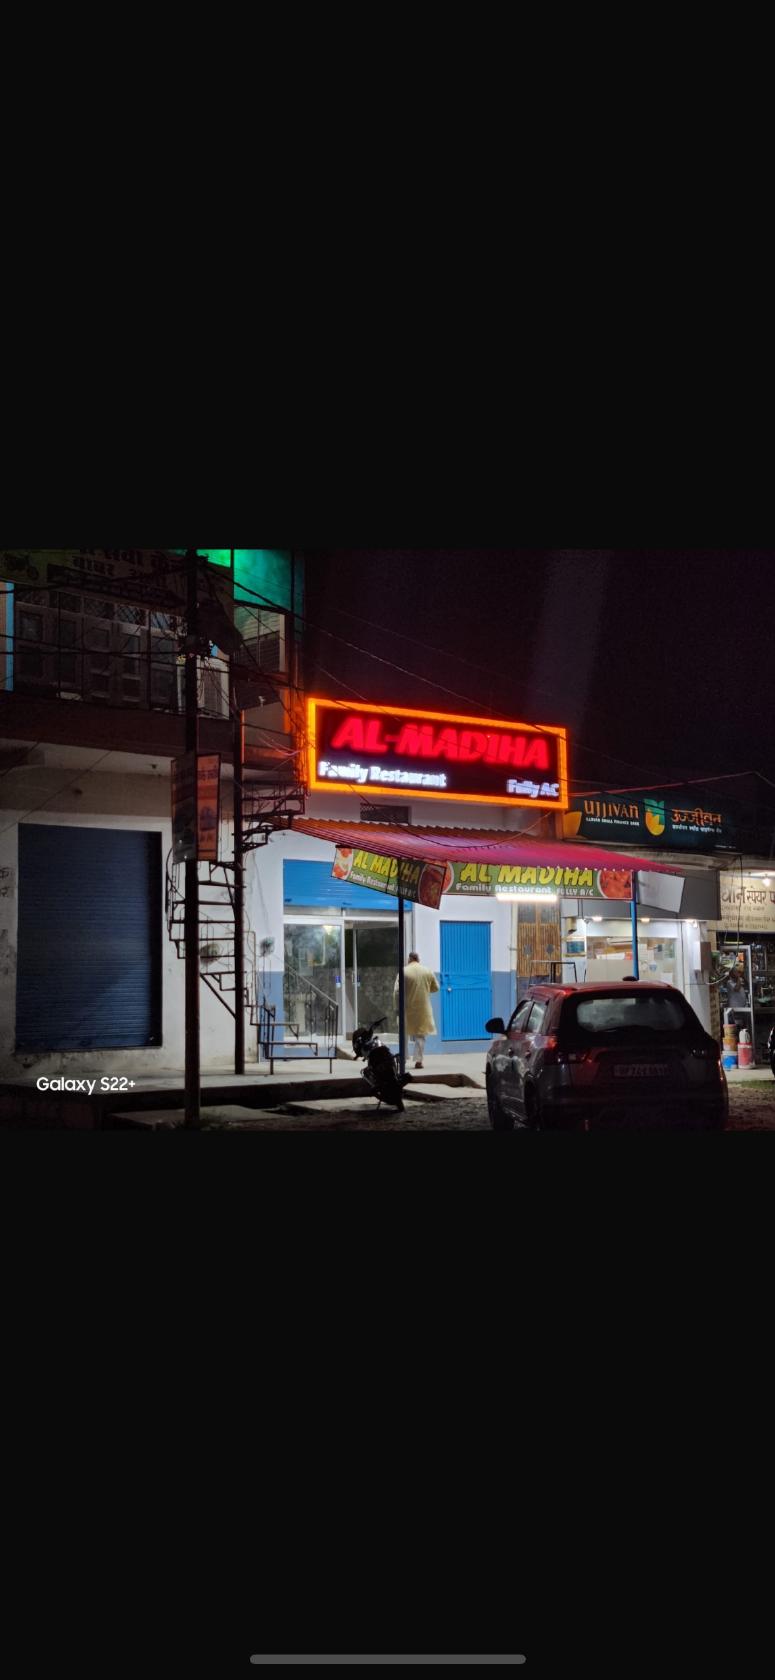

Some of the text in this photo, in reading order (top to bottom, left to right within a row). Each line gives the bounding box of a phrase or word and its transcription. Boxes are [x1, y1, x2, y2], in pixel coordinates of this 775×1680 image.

[331, 717, 549, 769] AL-MADIHA
[318, 761, 447, 788] Family Restaurant
[540, 783, 560, 797] AC
[353, 850, 369, 868] AL
[460, 863, 492, 882] AL
[455, 883, 491, 892] Family
[495, 885, 551, 894] Restaurant
[579, 889, 594, 897] A/C
